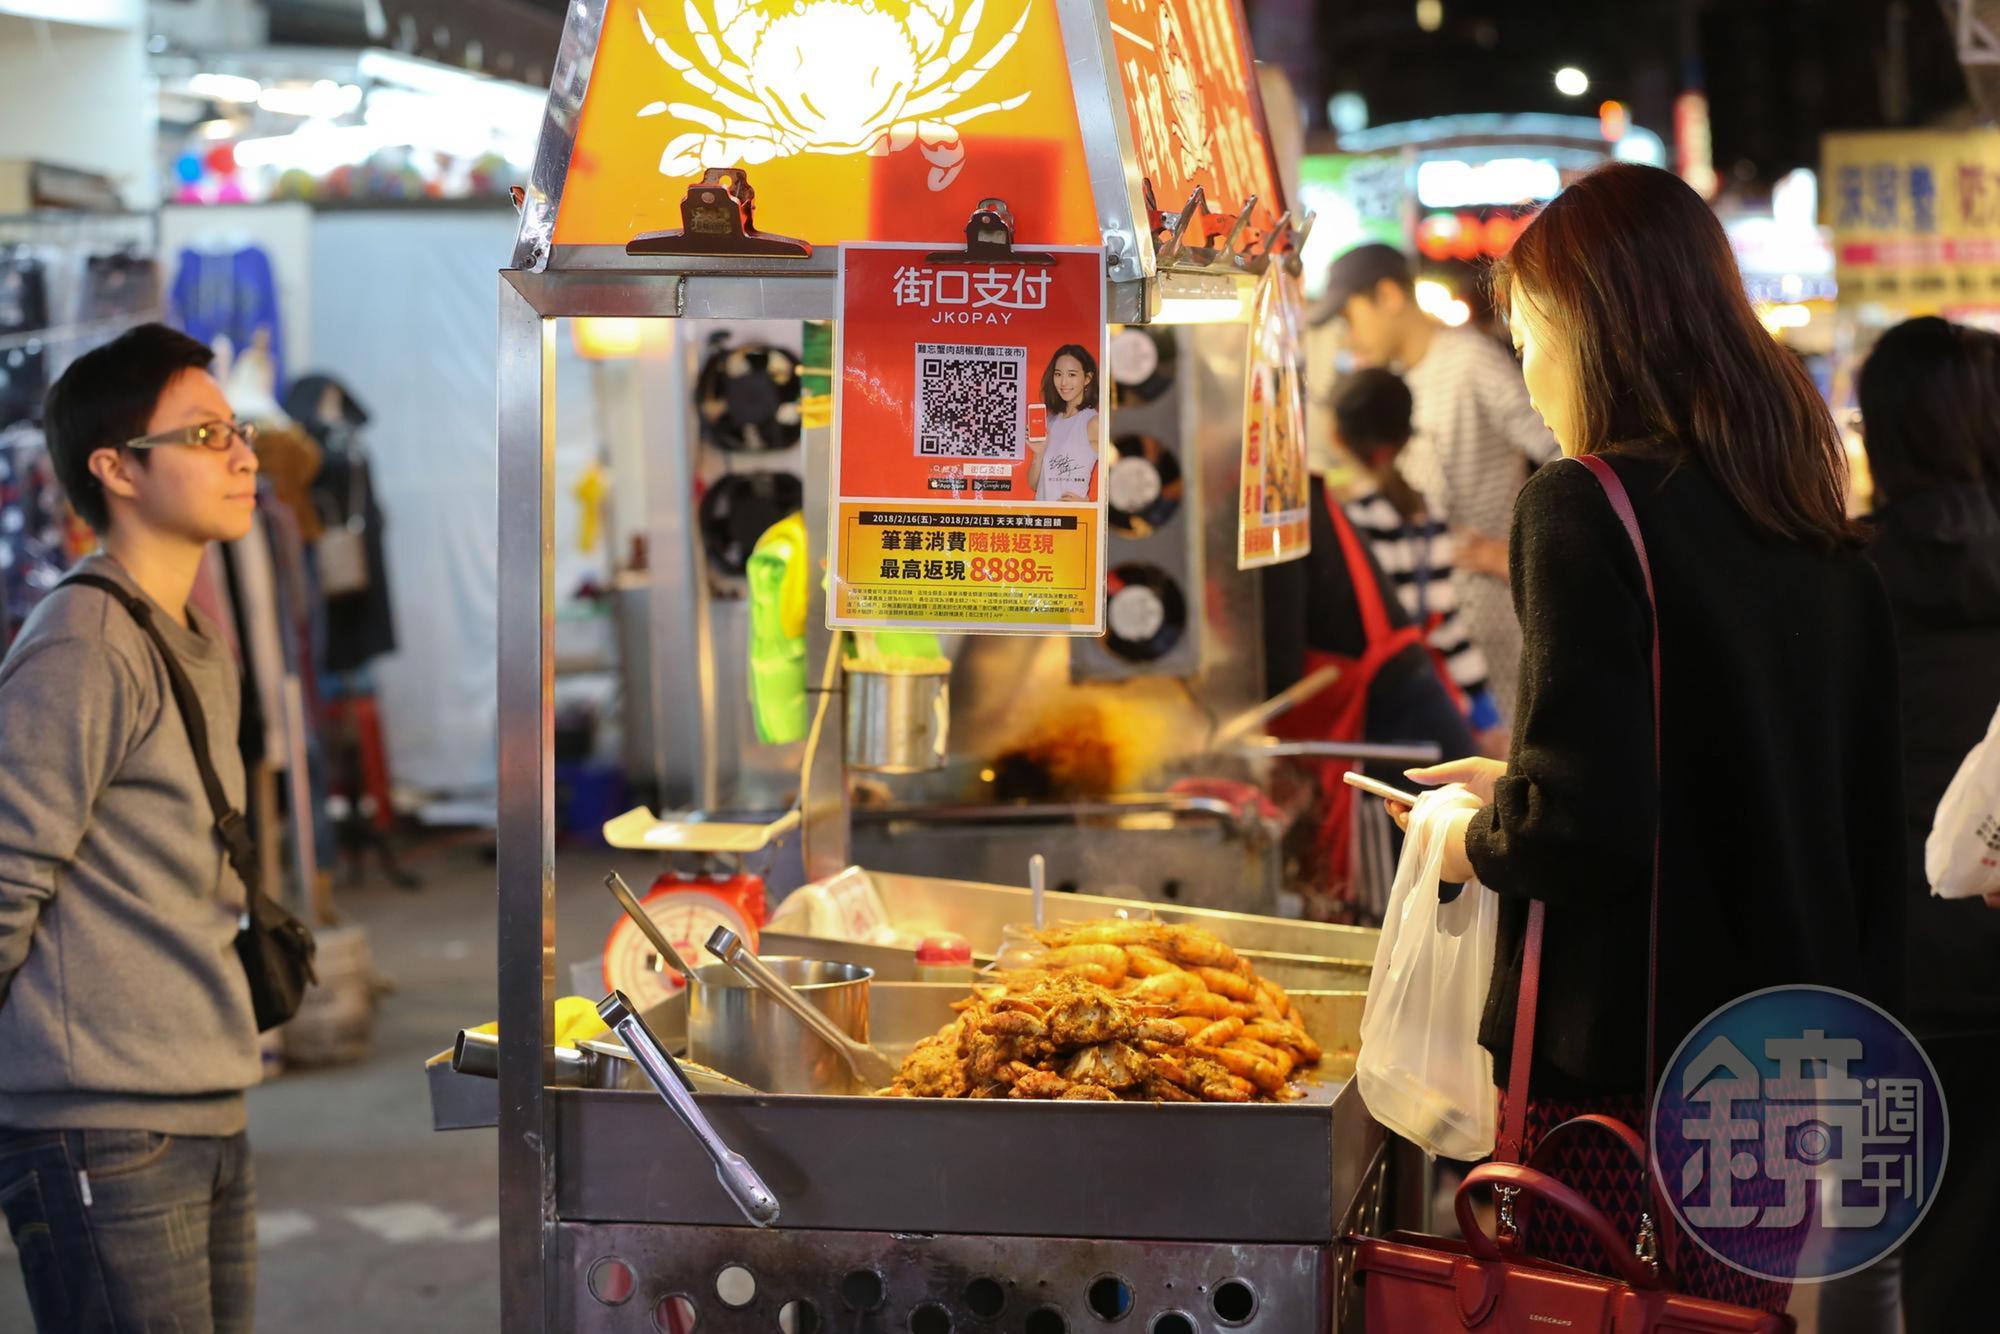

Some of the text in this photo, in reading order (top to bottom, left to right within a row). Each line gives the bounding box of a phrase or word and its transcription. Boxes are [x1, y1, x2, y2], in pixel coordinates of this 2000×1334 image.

[892, 265, 1052, 309] 街口支付
[932, 312, 1012, 324] JKOPAY
[940, 516, 994, 526] 2018/3/2(五)
